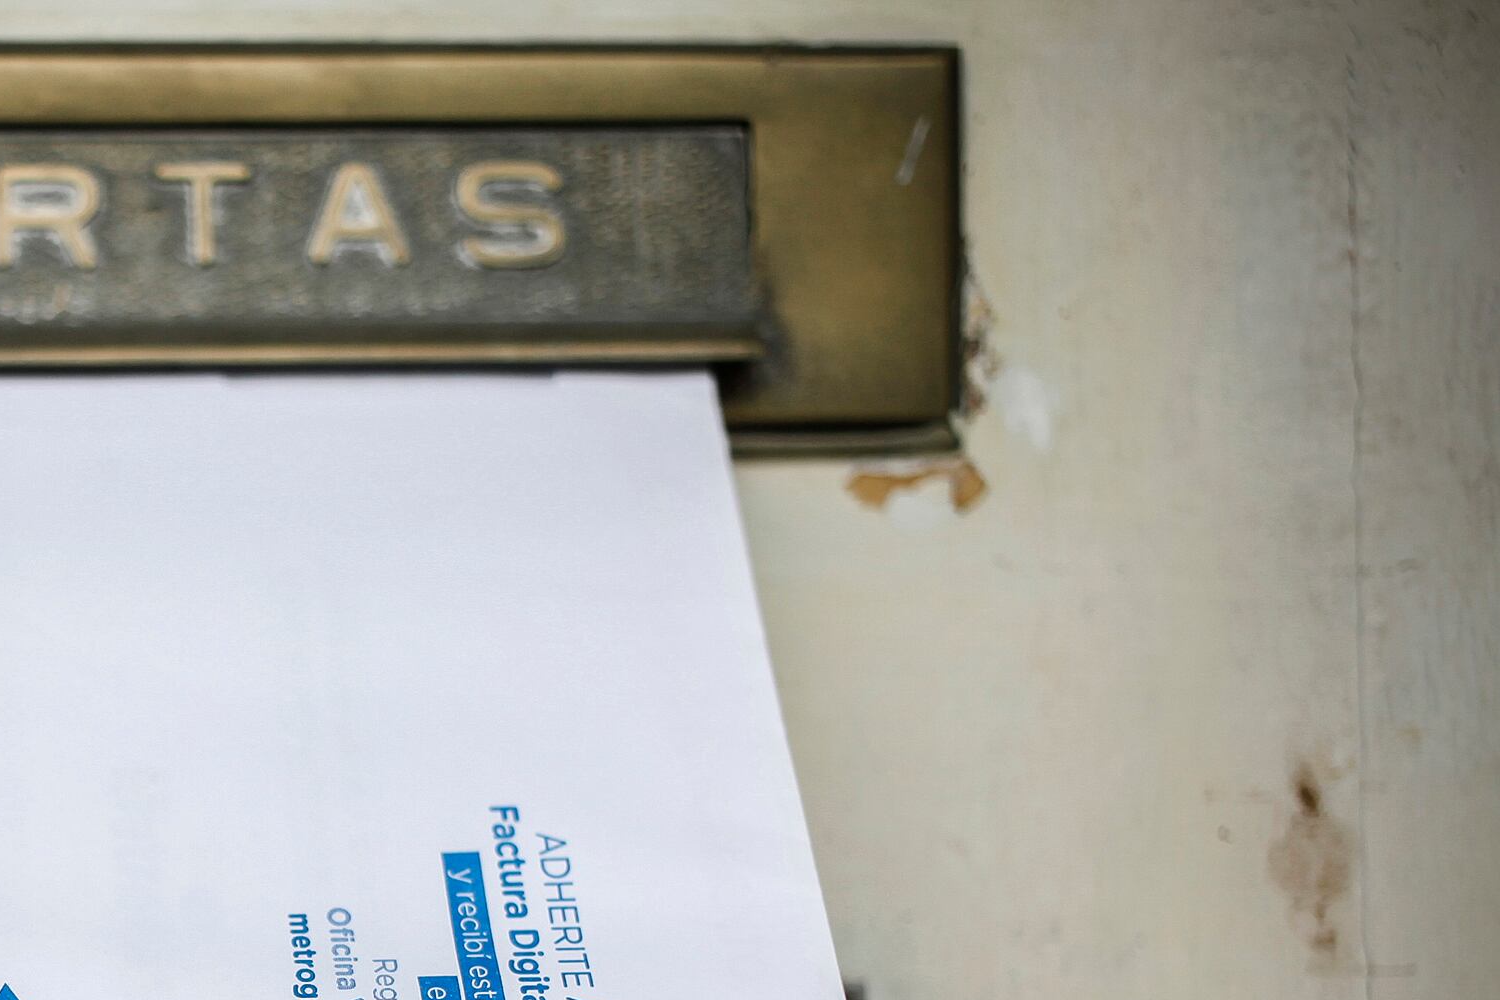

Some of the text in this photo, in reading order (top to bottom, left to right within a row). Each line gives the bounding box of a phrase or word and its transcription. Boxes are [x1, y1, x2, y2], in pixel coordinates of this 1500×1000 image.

[447, 867, 473, 884] y
[490, 805, 529, 919] Factura
[326, 907, 357, 991] Oficina
[456, 891, 492, 961] recibí
[535, 832, 595, 988] ADHERITE
